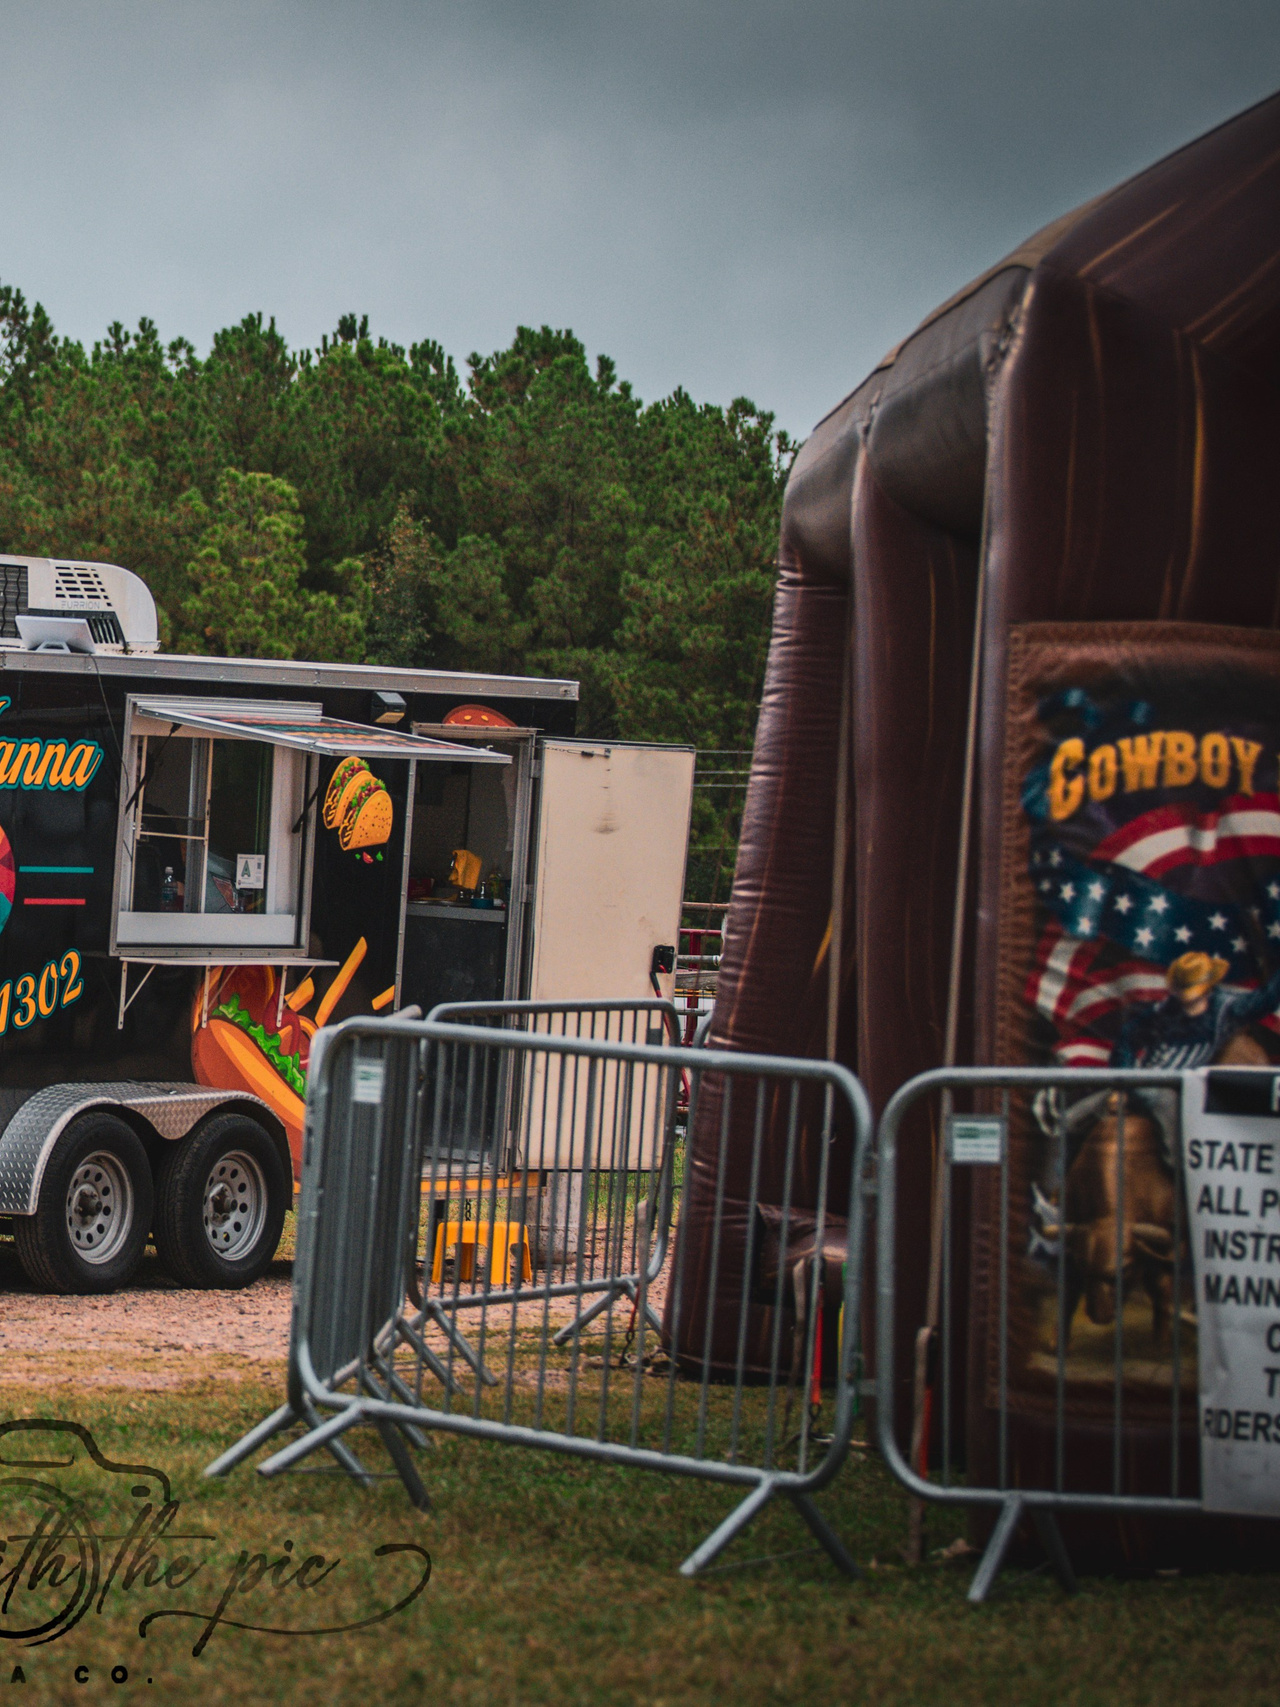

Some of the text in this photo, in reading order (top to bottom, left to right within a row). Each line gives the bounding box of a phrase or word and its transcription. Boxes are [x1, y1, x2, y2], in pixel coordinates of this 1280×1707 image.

[61, 600, 100, 609] FURRION
[1048, 730, 1264, 821] COWBOY
[1188, 1138, 1274, 1174] STATE
[1198, 1184, 1250, 1218] ALL
[1205, 1273, 1280, 1307] MANN
